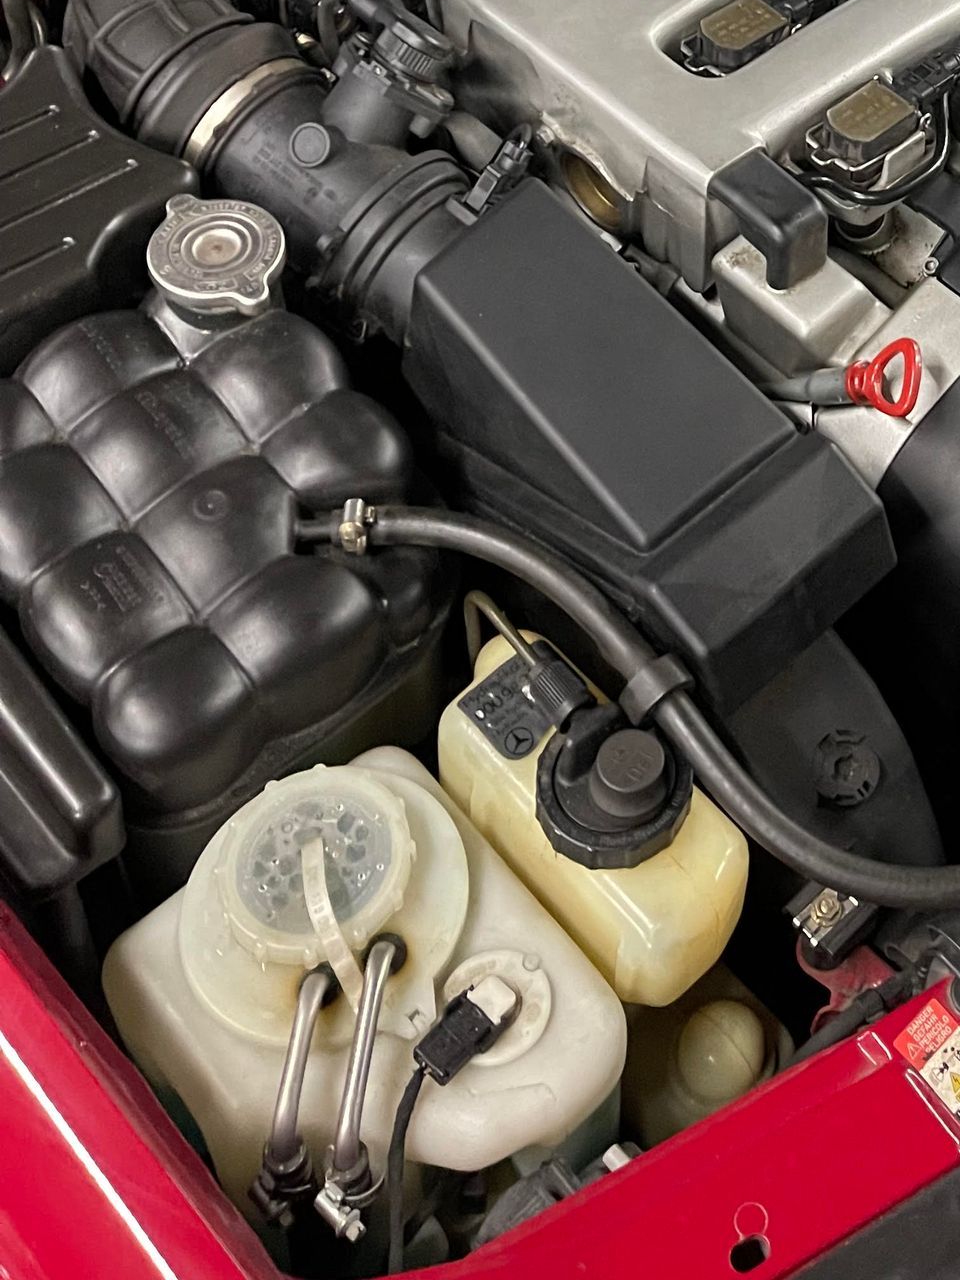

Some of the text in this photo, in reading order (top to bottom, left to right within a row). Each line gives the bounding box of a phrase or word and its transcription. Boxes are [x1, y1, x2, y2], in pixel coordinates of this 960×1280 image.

[905, 1004, 934, 1036] DANGER
[911, 1012, 938, 1043] GEFAHR
[917, 1013, 950, 1049] PERICOLO
